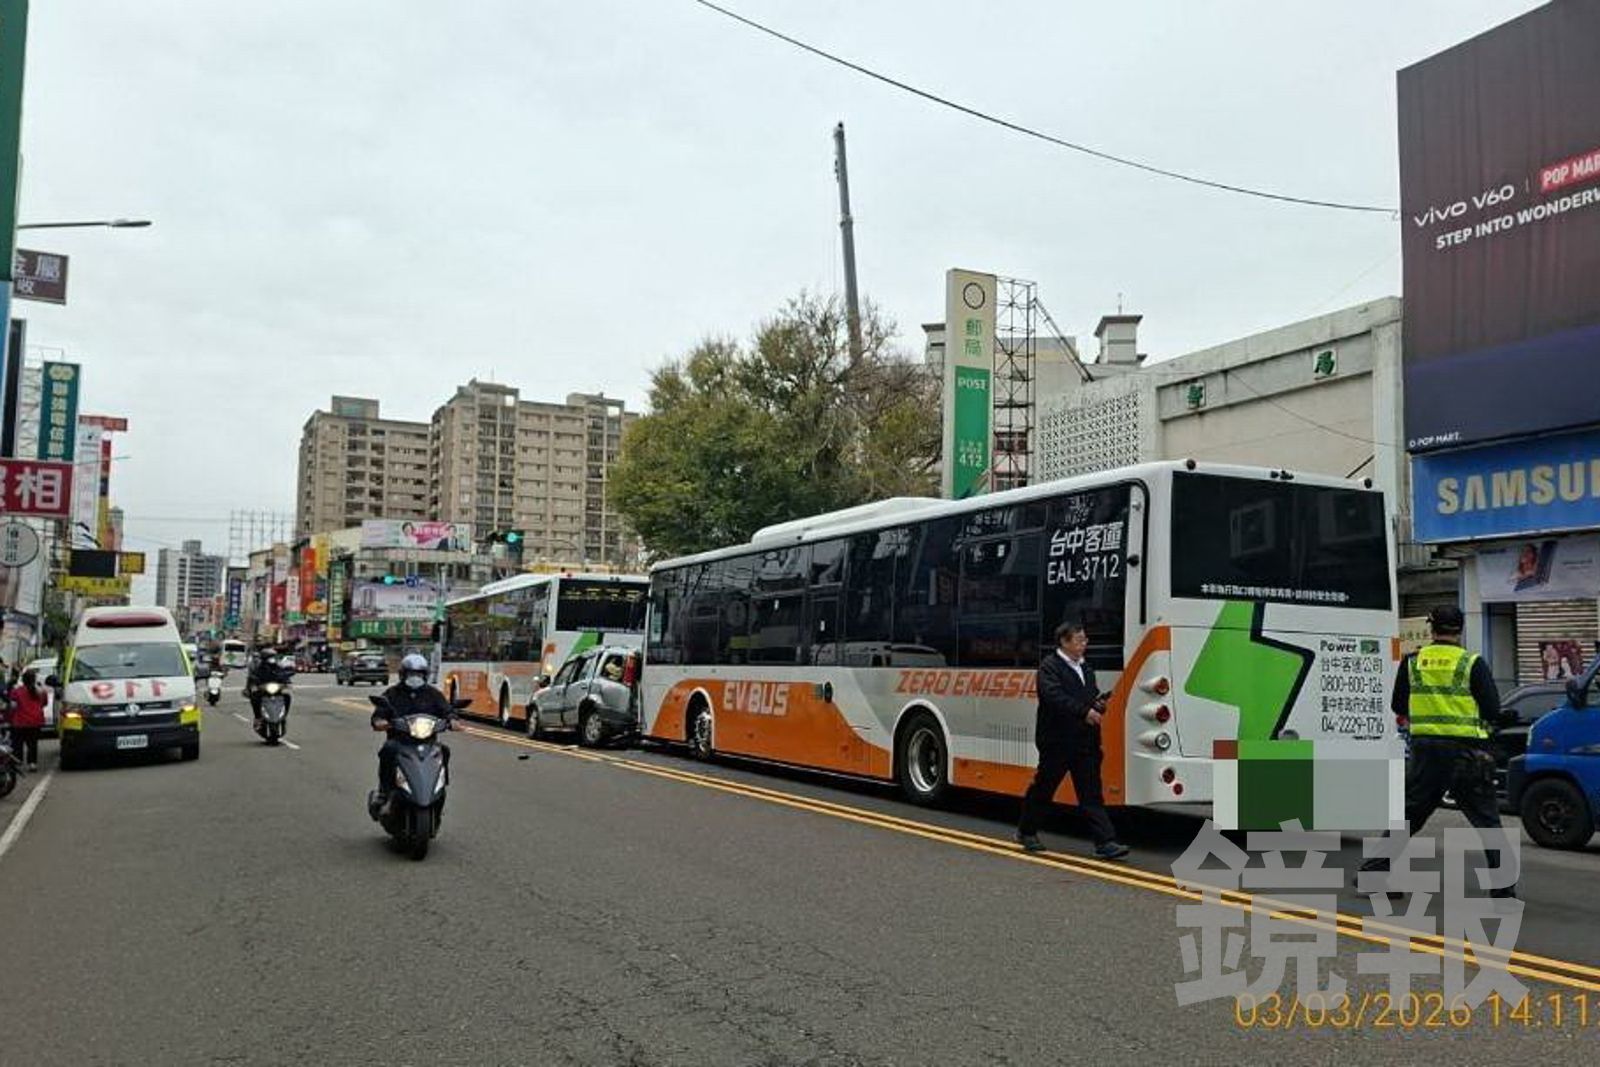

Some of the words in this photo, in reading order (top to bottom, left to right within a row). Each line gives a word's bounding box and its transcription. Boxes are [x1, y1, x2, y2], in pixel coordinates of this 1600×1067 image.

[1472, 184, 1516, 210] V60
[1541, 163, 1570, 188] POP
[1435, 227, 1473, 251] STEP
[1475, 214, 1514, 239] INTO
[964, 318, 983, 356] 郵局
[957, 376, 987, 391] POST
[959, 453, 983, 469] 412
[1049, 520, 1124, 556] 台中客運
[1047, 553, 1119, 585] EAL-3712
[1320, 640, 1357, 652] Power
[896, 670, 951, 696] ZERO
